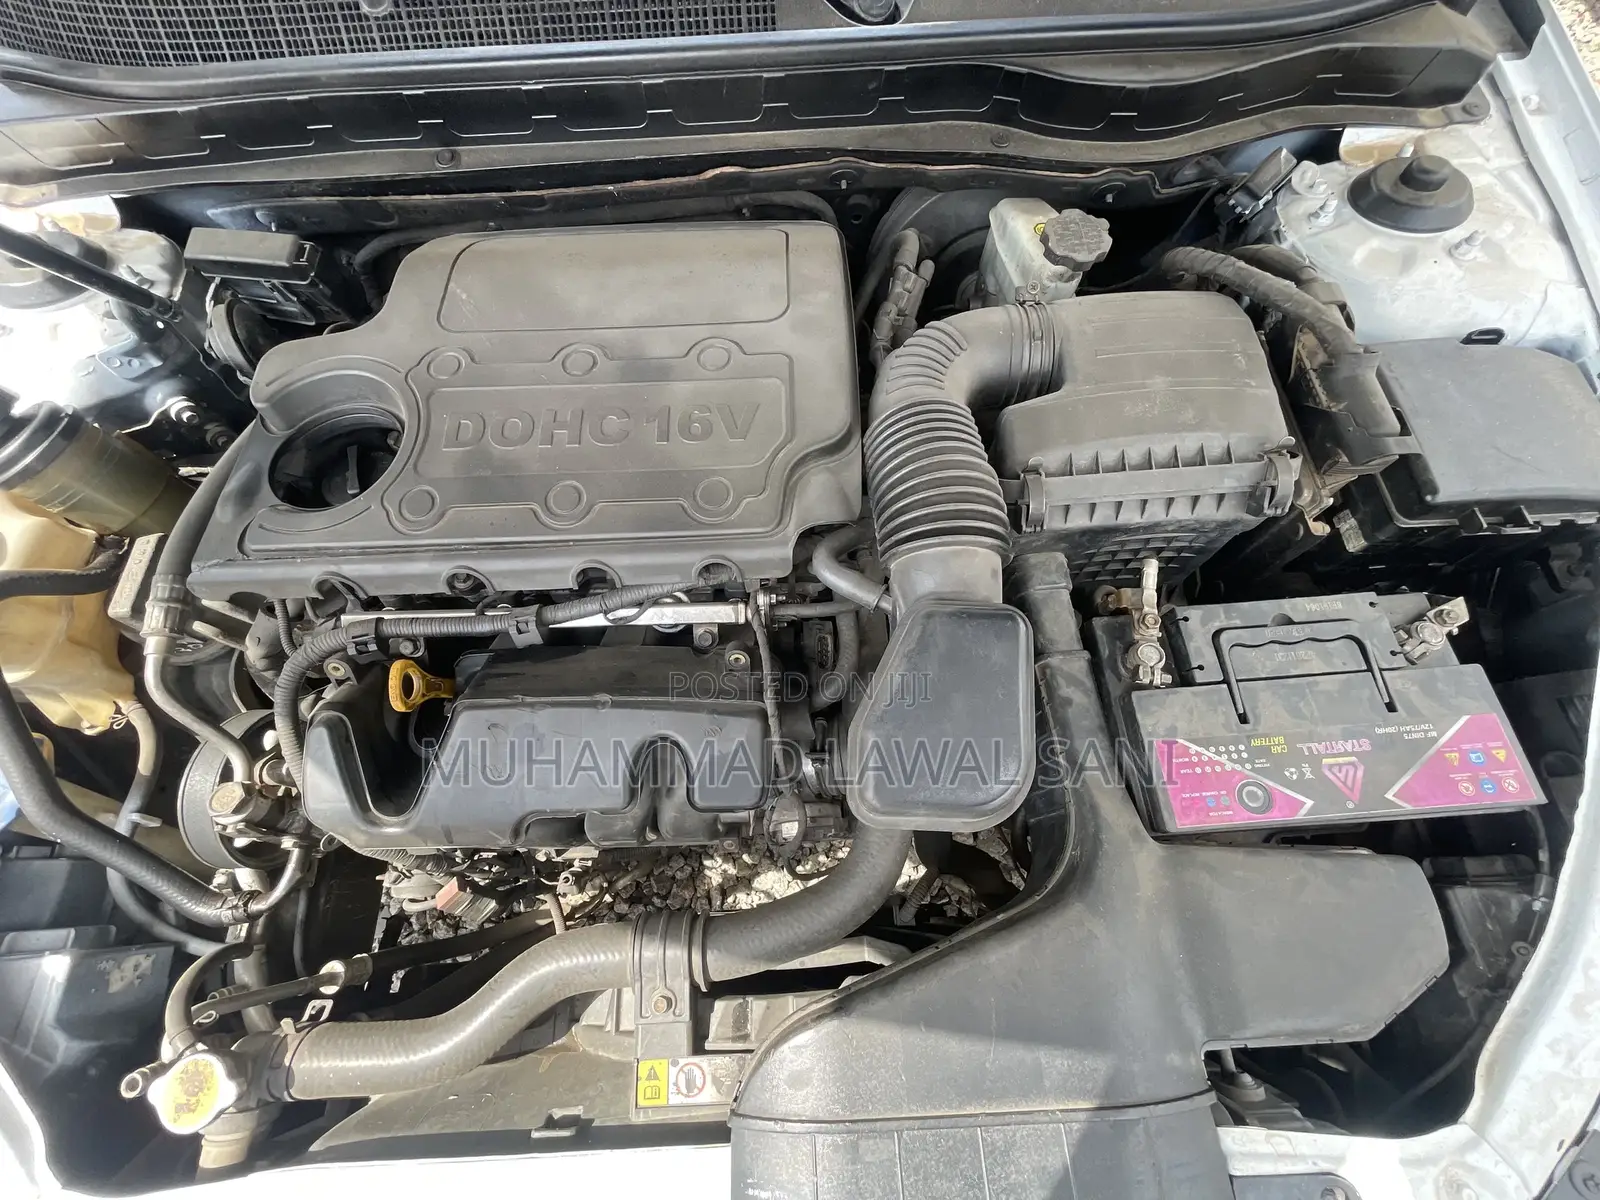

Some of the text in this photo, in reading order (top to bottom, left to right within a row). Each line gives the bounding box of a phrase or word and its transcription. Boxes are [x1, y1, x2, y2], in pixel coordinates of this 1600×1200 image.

[442, 403, 761, 451] DOHC 16V
[1250, 736, 1285, 748] BATTERY
[1271, 744, 1288, 754] CAR
[1296, 739, 1372, 756] STARTALL
